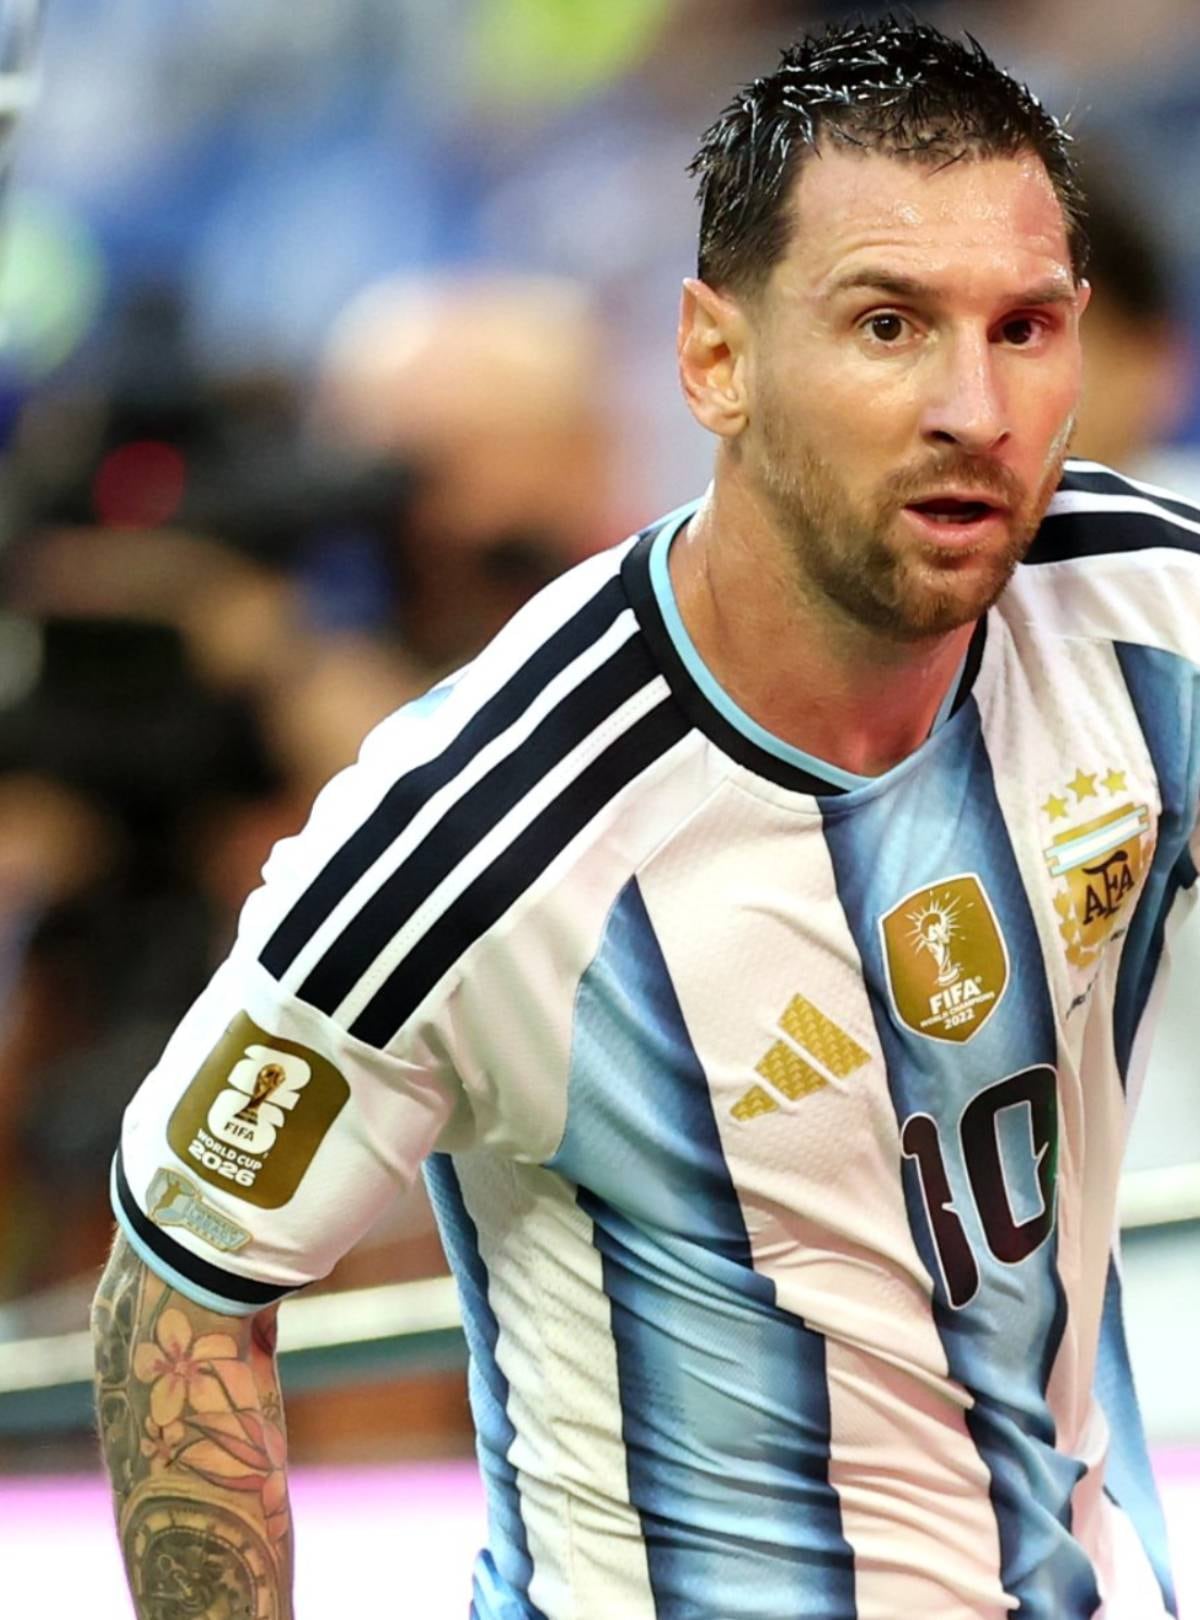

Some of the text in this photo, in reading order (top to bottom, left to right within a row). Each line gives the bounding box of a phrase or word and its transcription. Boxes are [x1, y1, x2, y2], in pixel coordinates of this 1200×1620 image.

[1082, 850, 1135, 925] AFA
[928, 978, 982, 1015] FIFA
[944, 1007, 976, 1031] 2022
[197, 1127, 263, 1171] WORLD CUP
[223, 1121, 256, 1142] FIFA
[187, 1139, 257, 1188] 2026
[900, 1063, 1059, 1311] 10
